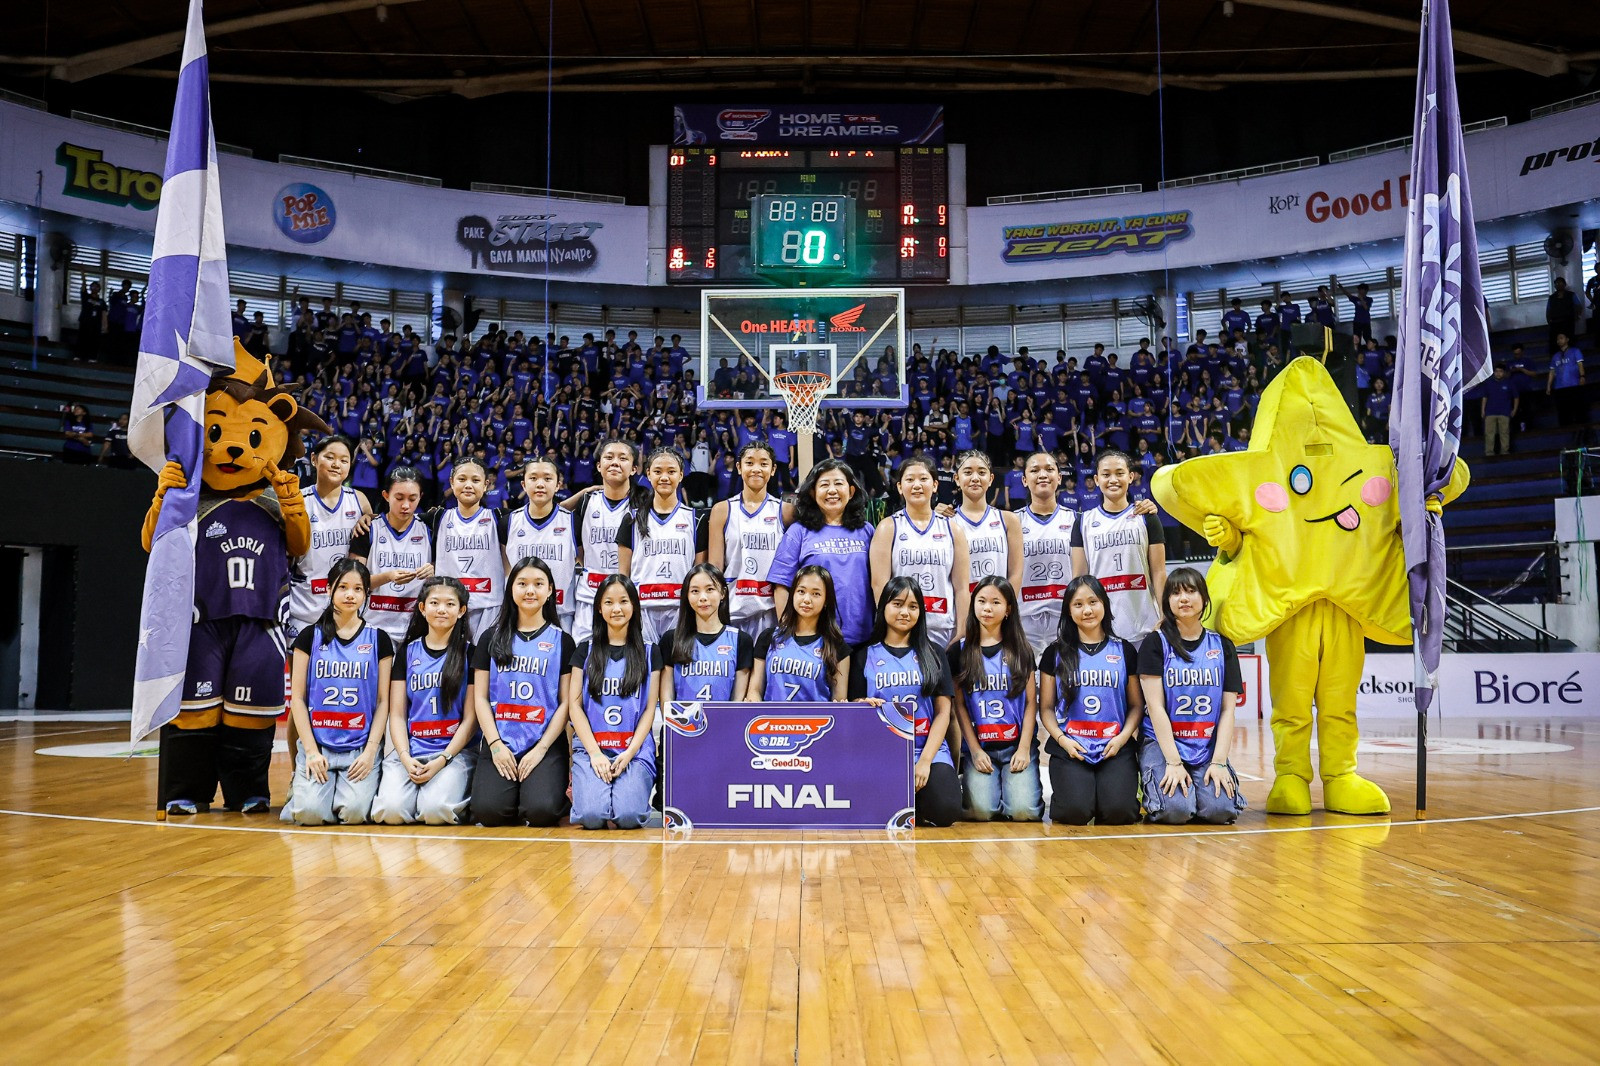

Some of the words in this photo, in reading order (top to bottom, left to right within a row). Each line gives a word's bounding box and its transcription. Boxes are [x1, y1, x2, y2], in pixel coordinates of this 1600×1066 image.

[779, 113, 840, 124] HOME
[779, 126, 899, 137] DREAMERS
[708, 155, 716, 165] 3
[64, 144, 162, 202] Taro
[800, 174, 816, 183] PERIOD
[282, 192, 318, 216] POP
[938, 205, 946, 215] 0
[1305, 179, 1392, 223] Good
[291, 207, 330, 231] MIE
[939, 215, 946, 225] 3
[1005, 227, 1044, 239] YANG
[1048, 222, 1100, 236] WORTH
[1125, 218, 1143, 228] YA
[1147, 212, 1188, 226] CUMA
[464, 226, 485, 239] PAKE
[488, 222, 604, 246] STREET
[938, 237, 946, 247] 0
[490, 249, 513, 263] GAYA
[516, 250, 548, 264] MAKIN
[708, 248, 715, 258] 2
[939, 247, 946, 257] 0
[741, 320, 768, 334] One
[770, 320, 816, 333] HEART.
[220, 536, 264, 556] GLORIA
[445, 534, 482, 552] GLORIA
[643, 539, 681, 557] GLORIA
[1093, 529, 1136, 550] GLORIA
[378, 551, 416, 569] GLORIA
[517, 544, 557, 560] GLORIA
[601, 550, 619, 569] 12
[899, 548, 941, 566] GLORIA
[457, 556, 474, 573] 7
[656, 561, 672, 578] 4
[745, 556, 758, 576] 9
[972, 559, 995, 577] 10
[1114, 553, 1122, 571] 1
[226, 556, 255, 590] 01
[1030, 561, 1063, 582] 28
[912, 572, 935, 591] 13
[316, 659, 361, 678] GLORIA
[364, 662, 368, 679] 1
[541, 659, 548, 677] 1
[681, 660, 722, 677] GLORIA
[724, 660, 728, 676] 1
[770, 655, 813, 679] GLORIA
[814, 664, 822, 680] 1
[875, 671, 921, 689] GLORIA
[1166, 667, 1212, 688] GLORIA
[1214, 668, 1220, 687] 1
[235, 686, 252, 702] 01
[322, 686, 359, 706] 25
[509, 681, 534, 700] 10
[696, 684, 712, 700] 4
[784, 683, 801, 700] 7
[1474, 670, 1583, 704] Bioré
[430, 696, 438, 714] 1
[978, 700, 1005, 719] 13
[1083, 695, 1101, 714] 9
[1175, 695, 1212, 715] 28
[604, 705, 622, 725] 6
[769, 737, 790, 746] DBL
[728, 784, 850, 808] FINAL
